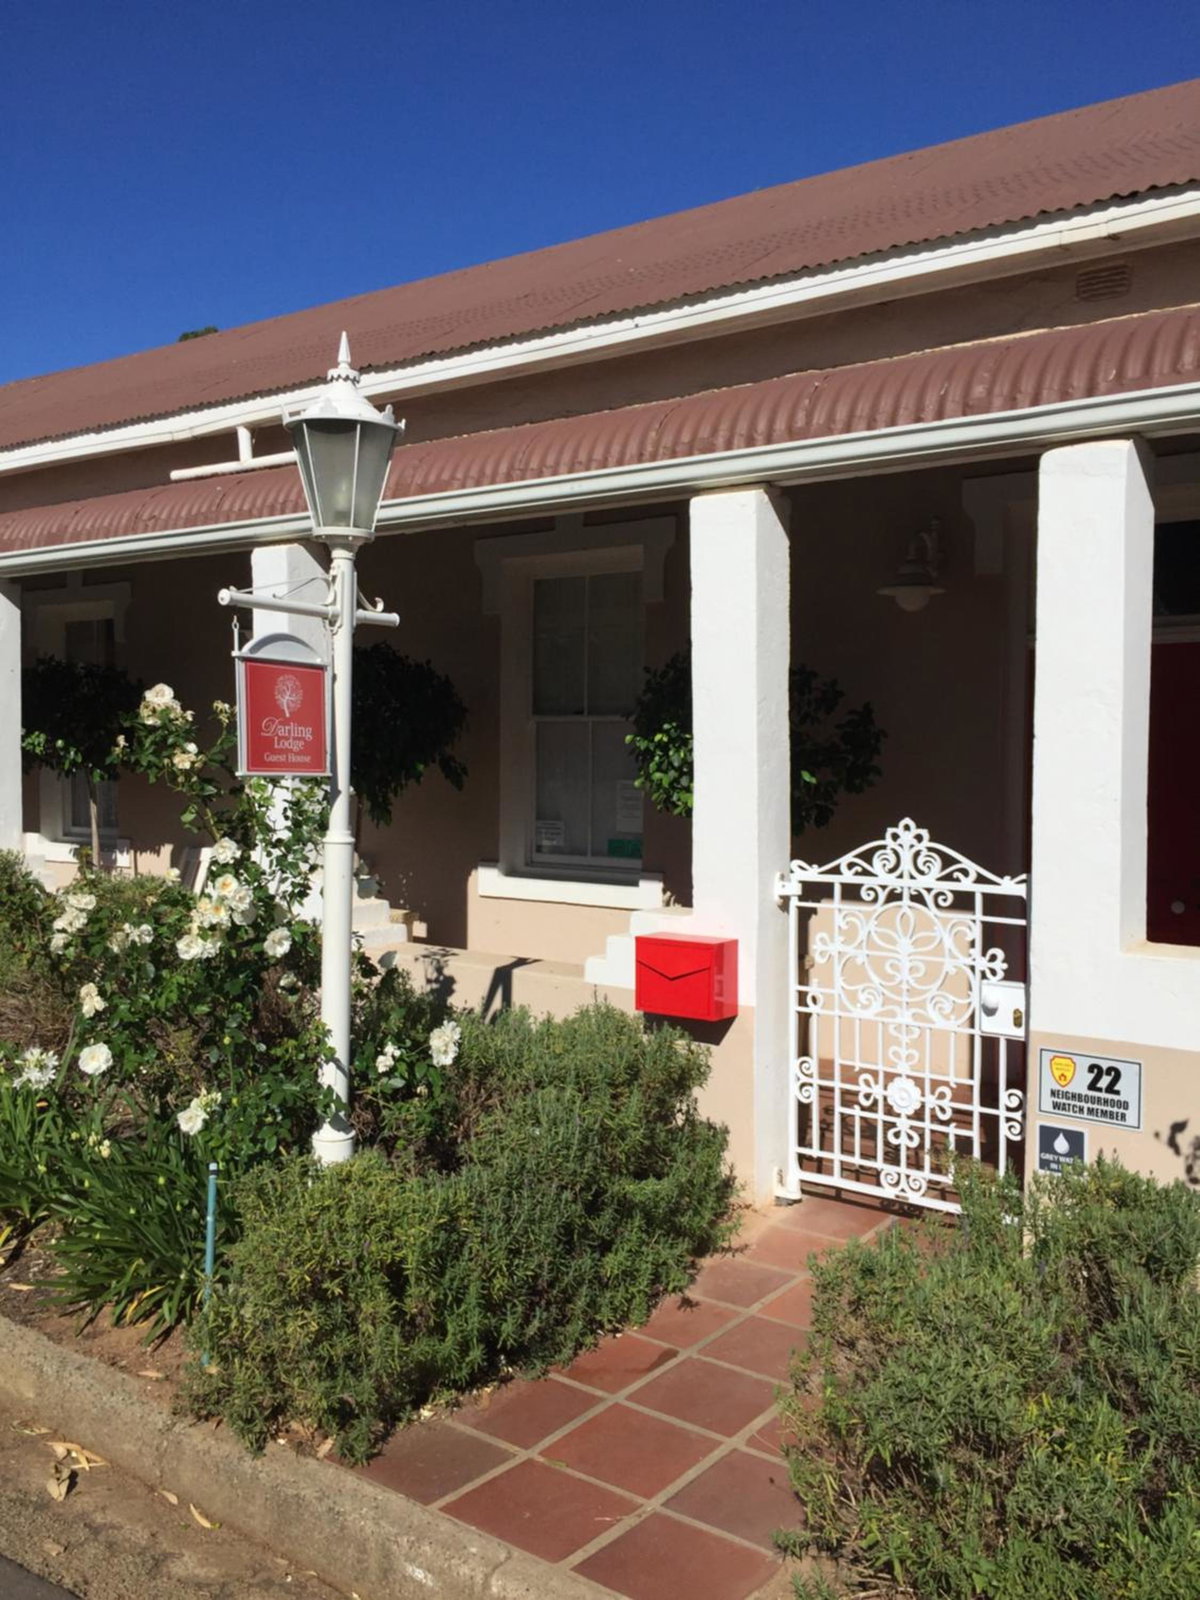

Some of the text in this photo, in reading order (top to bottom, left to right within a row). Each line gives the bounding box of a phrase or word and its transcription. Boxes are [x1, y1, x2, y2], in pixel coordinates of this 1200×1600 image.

[260, 716, 313, 741] Darling
[274, 736, 304, 752] Lodge
[264, 752, 311, 763] Guest House
[1087, 1063, 1122, 1096] 22
[1050, 1088, 1129, 1110] NEIGHBOURHOOD
[1052, 1100, 1127, 1122] WATCH MEMBER
